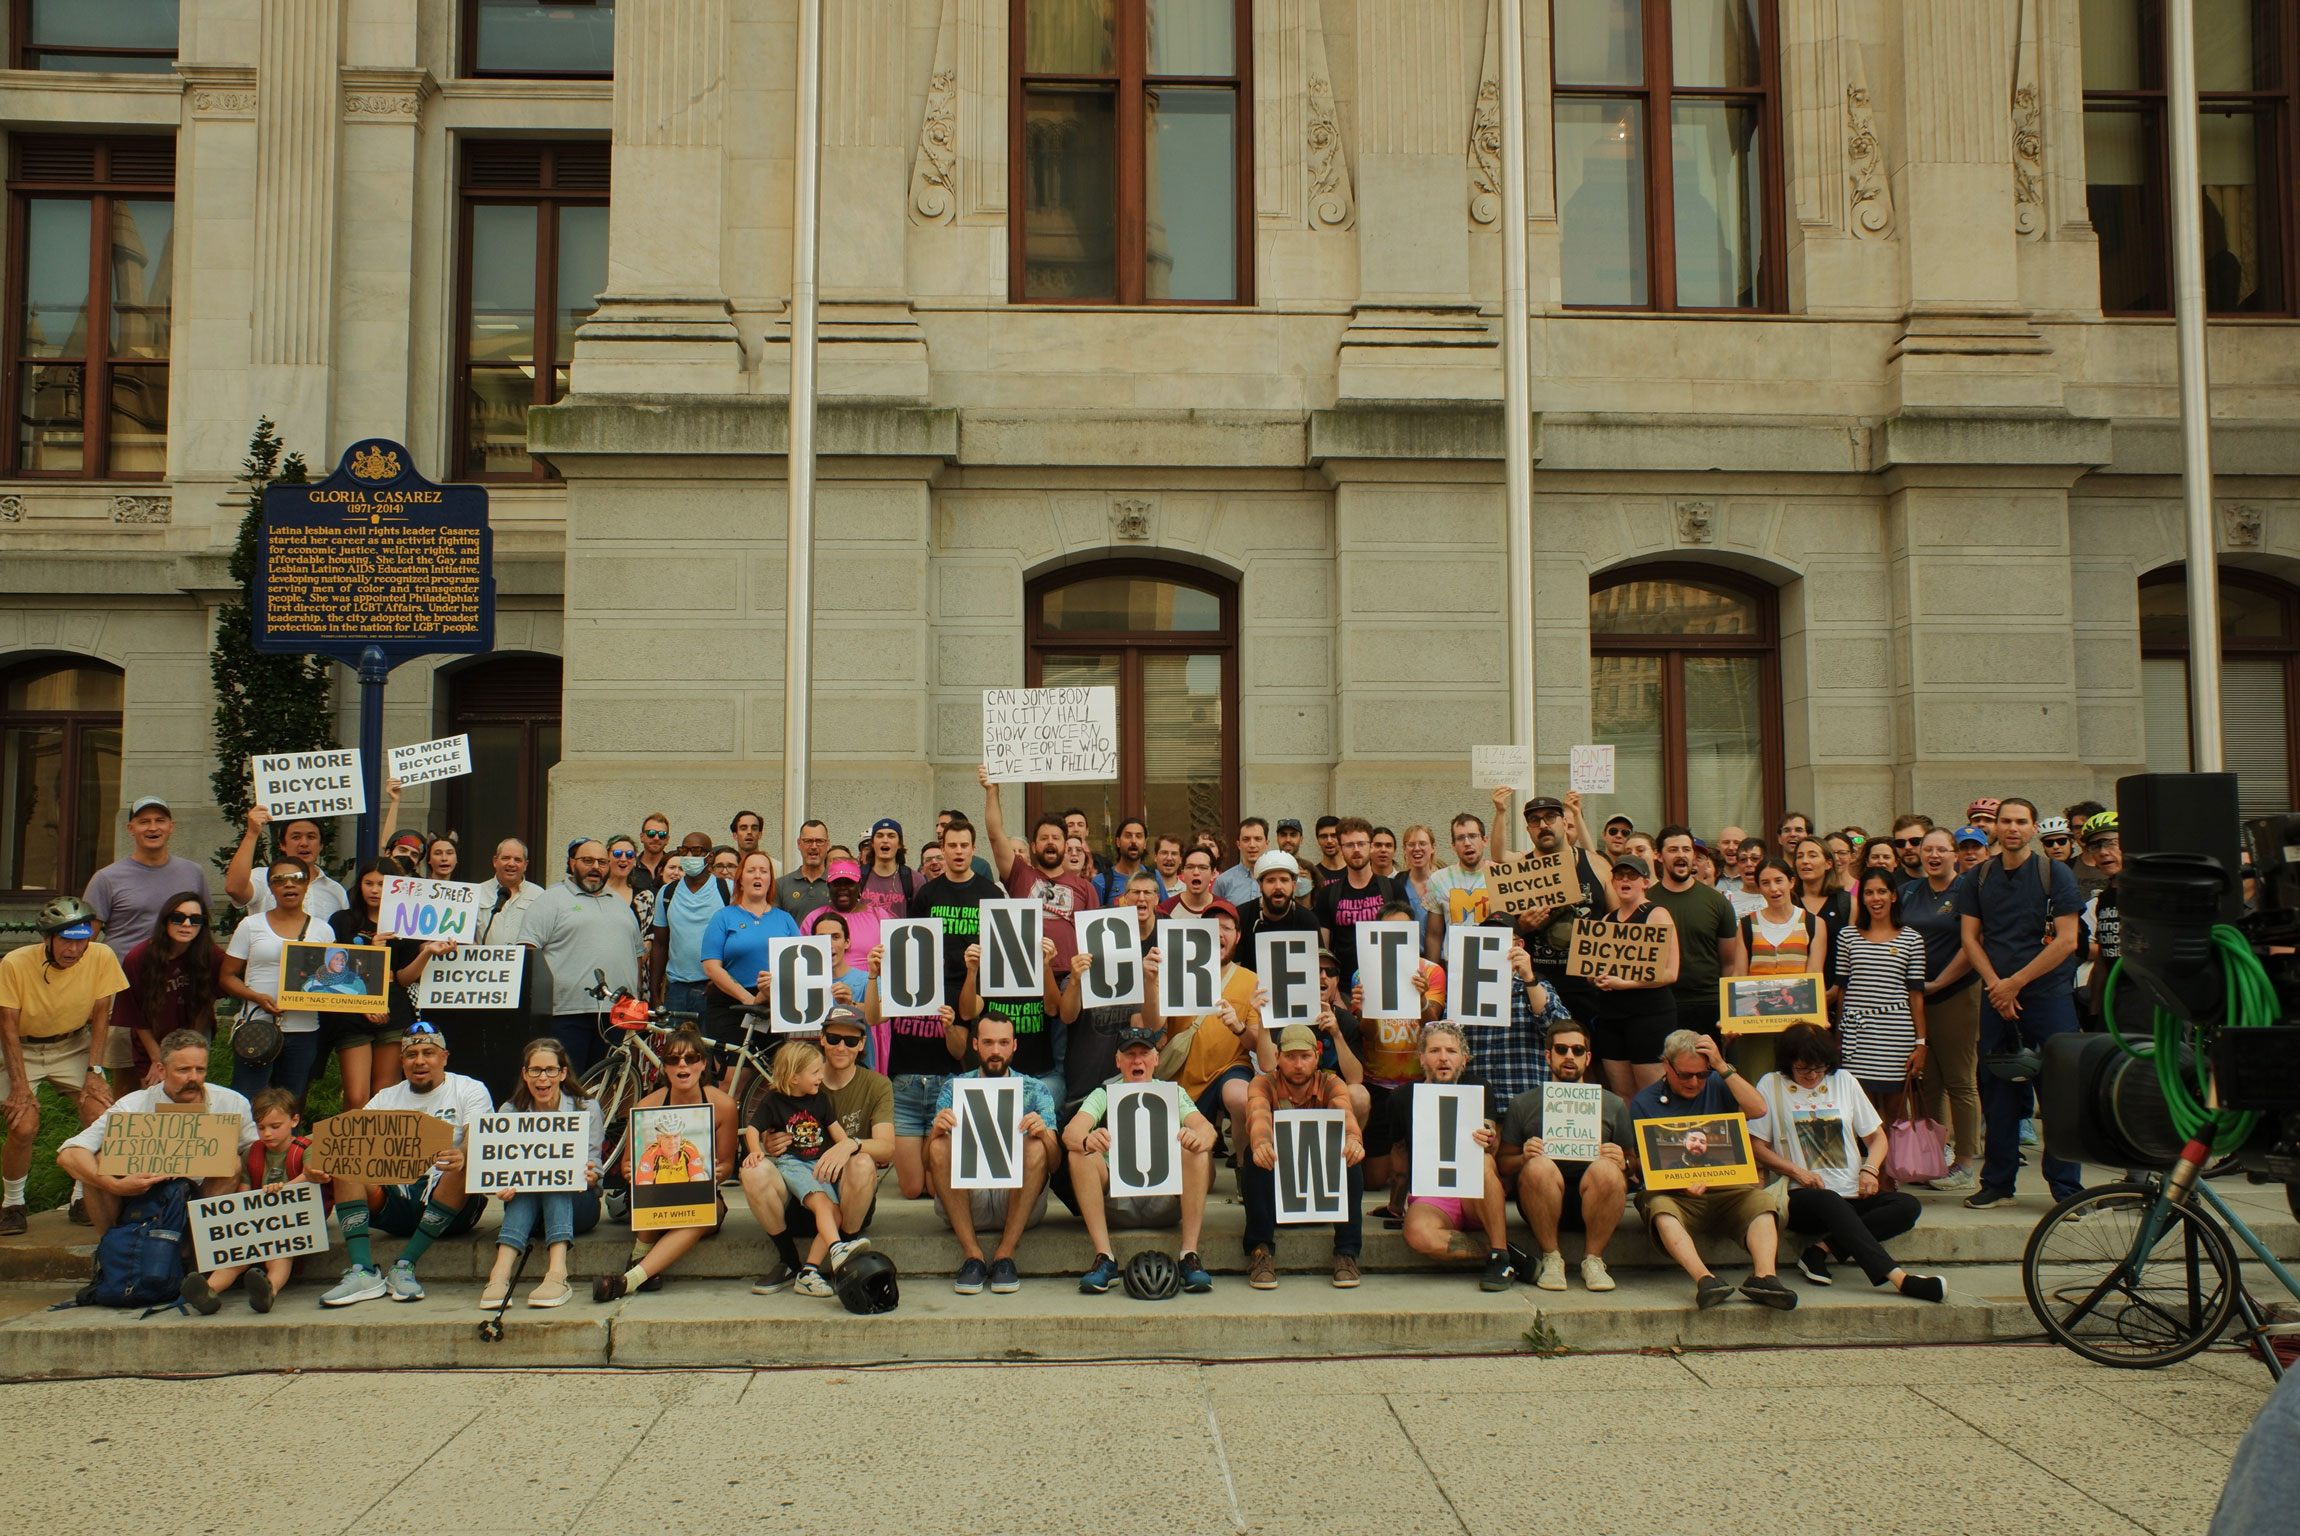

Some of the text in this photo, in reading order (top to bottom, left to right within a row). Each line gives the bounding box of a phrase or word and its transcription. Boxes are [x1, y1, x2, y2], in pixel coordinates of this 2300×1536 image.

[308, 490, 443, 503] GLORIA CASAREZ
[346, 504, 404, 514] (1971-2014)
[268, 526, 480, 537] Latina lesbian civil rights leader Casarez
[268, 536, 307, 545] started
[310, 536, 328, 545] her
[396, 536, 436, 545] activist
[438, 536, 480, 547] fighting
[268, 545, 422, 555] for economic welfare
[268, 555, 480, 566] affordable housing. led the and
[268, 564, 429, 574] Lesbian Latino AIDS Education
[268, 574, 480, 585] developing nationally recognized programs
[267, 584, 308, 595] serving
[339, 584, 353, 593] of
[357, 584, 385, 593] color
[390, 584, 410, 593] and
[414, 584, 480, 595] transgender
[353, 593, 406, 604] appointed
[408, 593, 480, 604] Philadelphia's
[267, 603, 480, 612] first director of LGBT Affairs. Under her
[326, 613, 479, 624] the city adopted the broadest
[267, 623, 479, 634] protections in the nation for LGBT people.
[988, 688, 1090, 706] CAN SOMEBODY
[987, 706, 1098, 724] IN CITY HALL
[986, 724, 1100, 742] SHOW CONCERN
[394, 737, 462, 759] NO MORE
[986, 738, 1110, 757] FOR PEOPLE WHO
[1573, 748, 1612, 764] DON'T
[262, 753, 353, 772] NO MORE
[399, 751, 460, 771] BICYCLE
[987, 752, 1116, 776] LIVE IN PHILLY?
[400, 764, 462, 785] DEATHS!
[1573, 765, 1612, 777] HIT ME
[268, 775, 351, 794] BICYCLE
[270, 797, 353, 817] DEATHS!
[1490, 854, 1562, 877] NO MORE
[429, 883, 474, 903] STREETS
[1498, 873, 1562, 894] BICYCLE
[1364, 894, 1384, 908] BIKE
[1505, 892, 1566, 913] DEATHS
[394, 902, 466, 936] NOW
[930, 906, 980, 919] PHILLY BIK
[1577, 920, 1668, 943] NO MORE
[432, 949, 516, 962] NO MORE
[990, 909, 1036, 987] N
[1578, 940, 1659, 962] BICYCLE
[890, 925, 935, 1008] O
[1086, 917, 1134, 999] C
[1167, 928, 1214, 1007] R
[433, 970, 510, 983] BICYCLE
[1270, 940, 1306, 1019] E
[1370, 931, 1408, 1010] T
[1461, 936, 1500, 1017] E
[1580, 960, 1656, 982] DEATHS
[778, 944, 823, 1025] C
[306, 996, 329, 1004] "NAS"
[331, 998, 385, 1006] CUNNINGHAM
[430, 991, 508, 1004] DEATHS!
[989, 1000, 1044, 1016] PHILLY BIKE
[894, 1018, 944, 1038] ACTION
[1380, 1025, 1420, 1044] DAY
[1546, 1086, 1601, 1100] CONCRETE
[1545, 1101, 1596, 1115] ACTION
[107, 1114, 239, 1139] RESTORE THE
[330, 1115, 423, 1137] COMMUNITY
[479, 1116, 580, 1134] NO MORE
[960, 1088, 1013, 1179] N
[1546, 1126, 1596, 1140] ACTUAL
[102, 1138, 219, 1157] VISION ZERO
[320, 1137, 422, 1158] SAFETY OVER
[1117, 1091, 1170, 1188] O
[1438, 1096, 1458, 1187] !
[482, 1143, 574, 1160] BICYCLE
[1543, 1142, 1600, 1157] CONCRETE
[127, 1156, 194, 1174] BUDGET
[322, 1157, 362, 1175] CAR'S
[1276, 1120, 1344, 1214] W
[1665, 1169, 1737, 1180] PABLO AVENDANO
[480, 1170, 574, 1188] DEATHS!
[200, 1187, 312, 1218] NO MORE
[670, 1210, 696, 1218] WHITE
[209, 1212, 310, 1242] BICYCLE
[213, 1235, 314, 1265] DEATHS!
